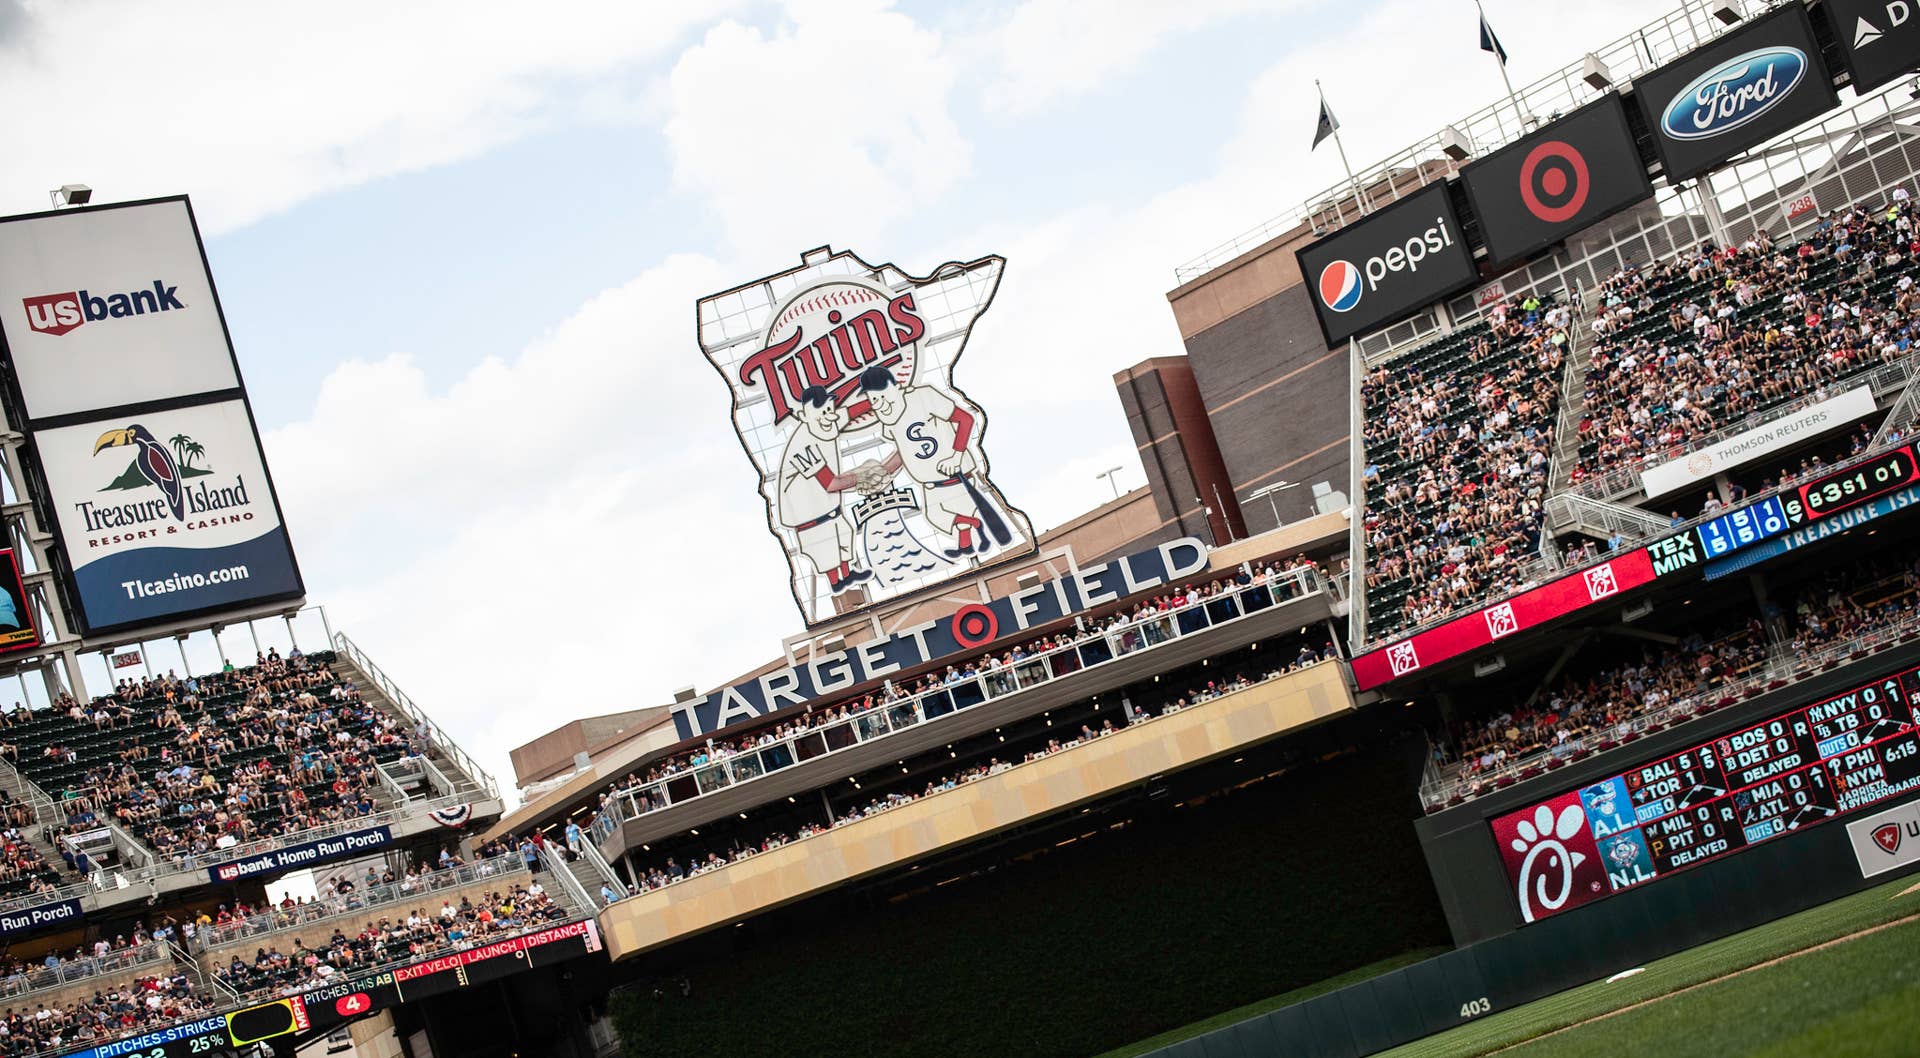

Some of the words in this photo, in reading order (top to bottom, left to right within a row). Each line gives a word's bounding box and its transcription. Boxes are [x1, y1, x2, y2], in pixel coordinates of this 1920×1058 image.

[1693, 63, 1778, 129] Ford
[1790, 196, 1811, 213] 238
[1366, 217, 1451, 291] pepsi
[28, 280, 185, 330] usbank
[740, 292, 925, 425] Twins
[1717, 432, 1774, 461] THOMSON
[1777, 411, 1828, 438] REUTERS
[794, 445, 821, 472] M
[75, 498, 168, 532] Treasure
[184, 474, 251, 514] Island
[1786, 499, 1802, 514] 6
[89, 529, 157, 548] RESORT
[166, 526, 177, 534] &
[187, 512, 254, 530] CASINO
[1648, 531, 1694, 559] TEX
[1708, 521, 1719, 537] 1
[1733, 510, 1749, 527] 5
[1762, 501, 1773, 516] 1
[1781, 502, 1879, 550] TREASURE
[1653, 548, 1697, 576] MIN
[1711, 536, 1728, 553] 5
[1738, 526, 1754, 543] 5
[122, 564, 249, 599] TIcasino.com
[668, 620, 938, 740] TARGET
[1010, 537, 1208, 630] FIELD
[1825, 694, 1857, 717] NYY
[1863, 688, 1876, 703] 0
[1888, 688, 1899, 702] 1
[1835, 715, 1859, 732] TB
[1869, 705, 1882, 720] 0
[1731, 729, 1767, 750] BOS
[1770, 722, 1783, 736] 0
[1793, 722, 1808, 737] R
[1820, 739, 1847, 758] OUTS
[1703, 754, 1715, 769] 5
[1738, 745, 1770, 764] DET
[1776, 738, 1789, 753] 0
[1844, 748, 1876, 770] PHI
[1885, 740, 1917, 762] 6:15
[1641, 762, 1675, 783] BAL
[1679, 754, 1691, 769] 5
[1743, 754, 1801, 784] DELAYED
[1814, 774, 1824, 788] 1
[1846, 763, 1884, 789] NYM
[1646, 777, 1681, 799] TOR
[1685, 771, 1696, 786] 1
[1751, 784, 1784, 804] MIA
[1788, 774, 1802, 789] 0
[1638, 803, 1664, 821] OUTS
[1758, 799, 1790, 819] ATL
[1794, 791, 1807, 806] 0
[1594, 812, 1638, 840] A.L.
[1661, 814, 1692, 834] MIL
[1697, 807, 1710, 821] 0
[1721, 807, 1734, 822] R
[1746, 823, 1773, 842] OUTS
[1668, 829, 1695, 851] PIT
[1703, 823, 1716, 837] 0
[219, 857, 276, 881] usbank
[277, 846, 316, 867] Home
[318, 838, 345, 857] Run
[346, 830, 385, 851] Porch
[1670, 839, 1728, 867] DELAYED
[1609, 864, 1657, 890] N.L.
[1, 914, 31, 931] Run
[33, 904, 73, 925] Porch
[528, 922, 586, 947] DISTANCE
[467, 941, 517, 963] LAUNCH
[397, 963, 426, 981] EXIT
[428, 957, 459, 974] VELO
[304, 984, 350, 1005] PITCHES
[351, 976, 374, 993] THIS
[376, 973, 393, 987] AB
[346, 995, 361, 1011] 4
[290, 996, 308, 1029] MPH
[1460, 997, 1491, 1018] 403
[100, 1016, 226, 1058] PITCHES-STRIKES
[190, 1034, 224, 1053] 25%
